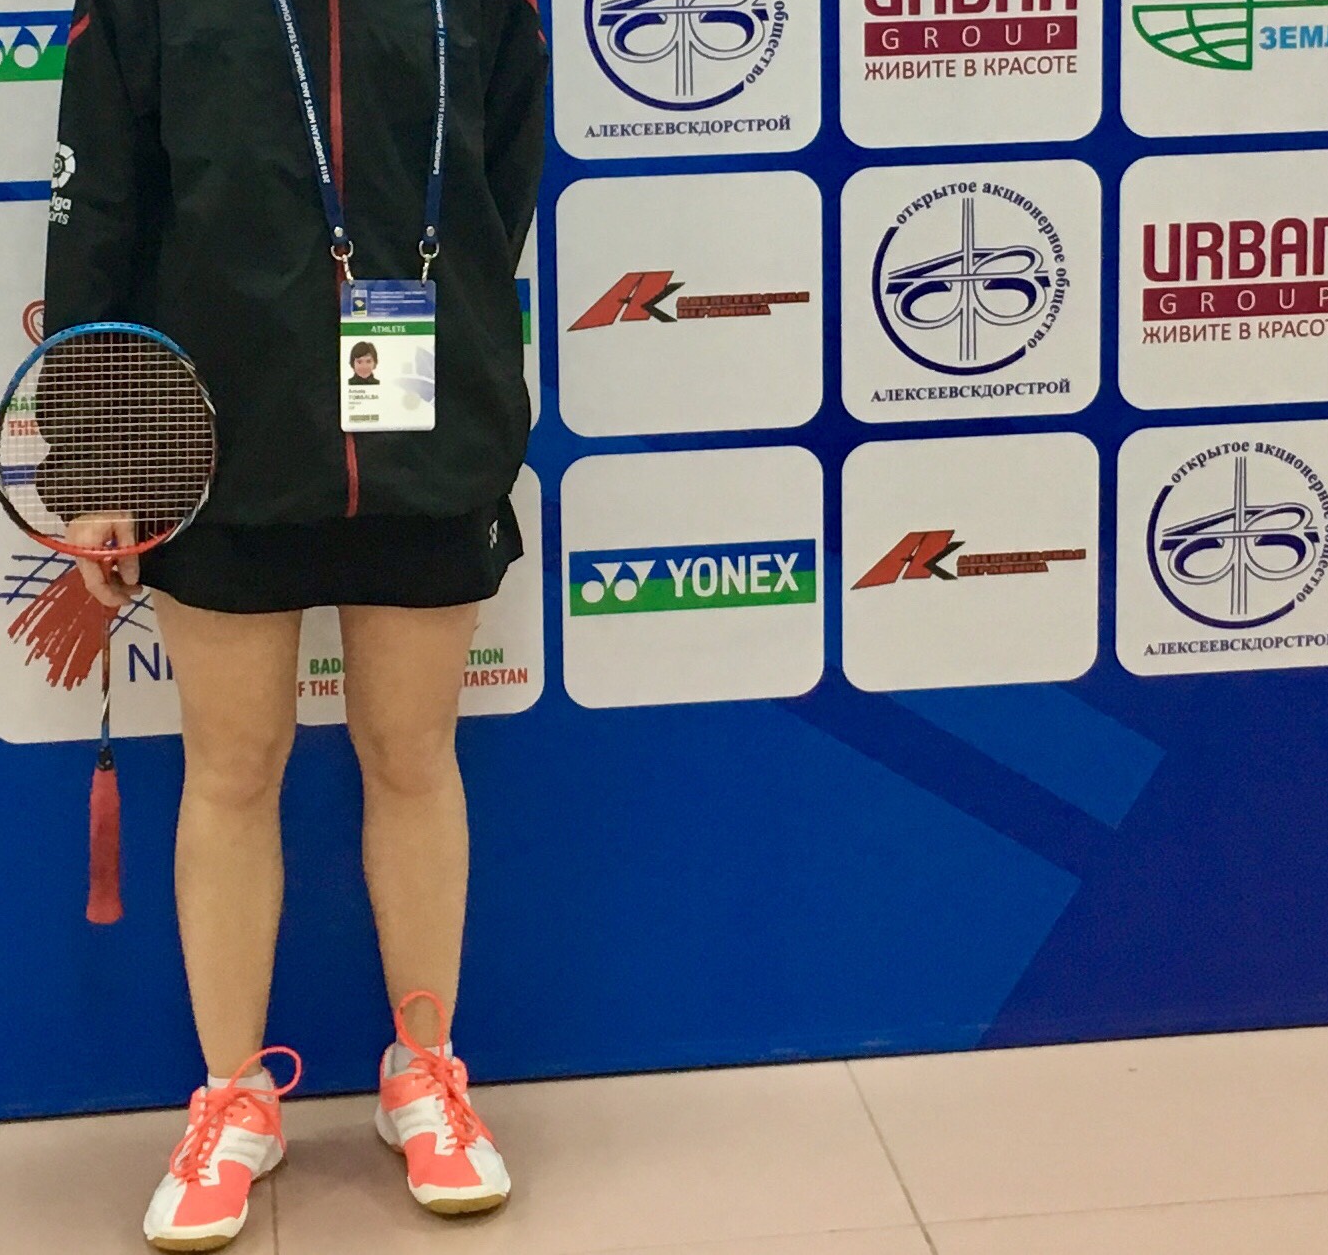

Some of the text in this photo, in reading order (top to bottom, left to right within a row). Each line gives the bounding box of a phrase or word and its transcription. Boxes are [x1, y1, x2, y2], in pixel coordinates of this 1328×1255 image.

[882, 22, 1061, 51] GROUP
[864, 55, 1078, 81] ЖИВИТЕ В КРАСОТЕ
[584, 114, 791, 140] АЛЕКСЕЕВСКДОРСТРОЙ
[1143, 324, 1233, 345] ЖИВИТЕ
[1240, 323, 1252, 341] В
[871, 378, 1071, 404] АЛЕКСЕЕВСКДОРСТРОЙ
[665, 552, 800, 600] YONEX
[465, 668, 528, 687] TARSTAN
